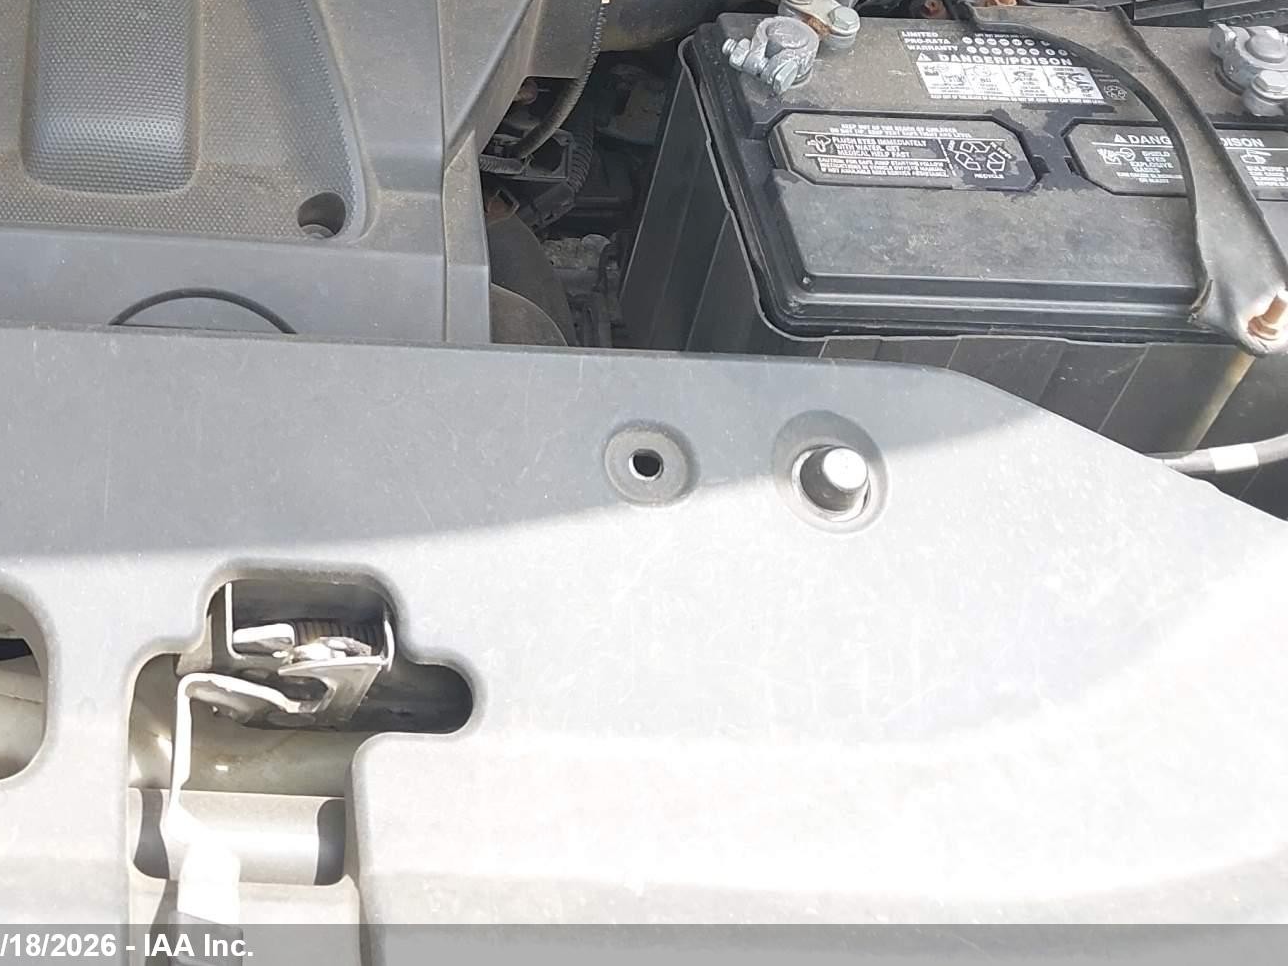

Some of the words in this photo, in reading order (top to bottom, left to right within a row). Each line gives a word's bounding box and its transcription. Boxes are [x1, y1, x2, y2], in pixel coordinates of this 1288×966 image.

[906, 44, 959, 52] WARRANTY
[937, 54, 1073, 66] DANGER/POISON
[832, 136, 856, 144] FLUSH
[1127, 134, 1173, 145] DANG
